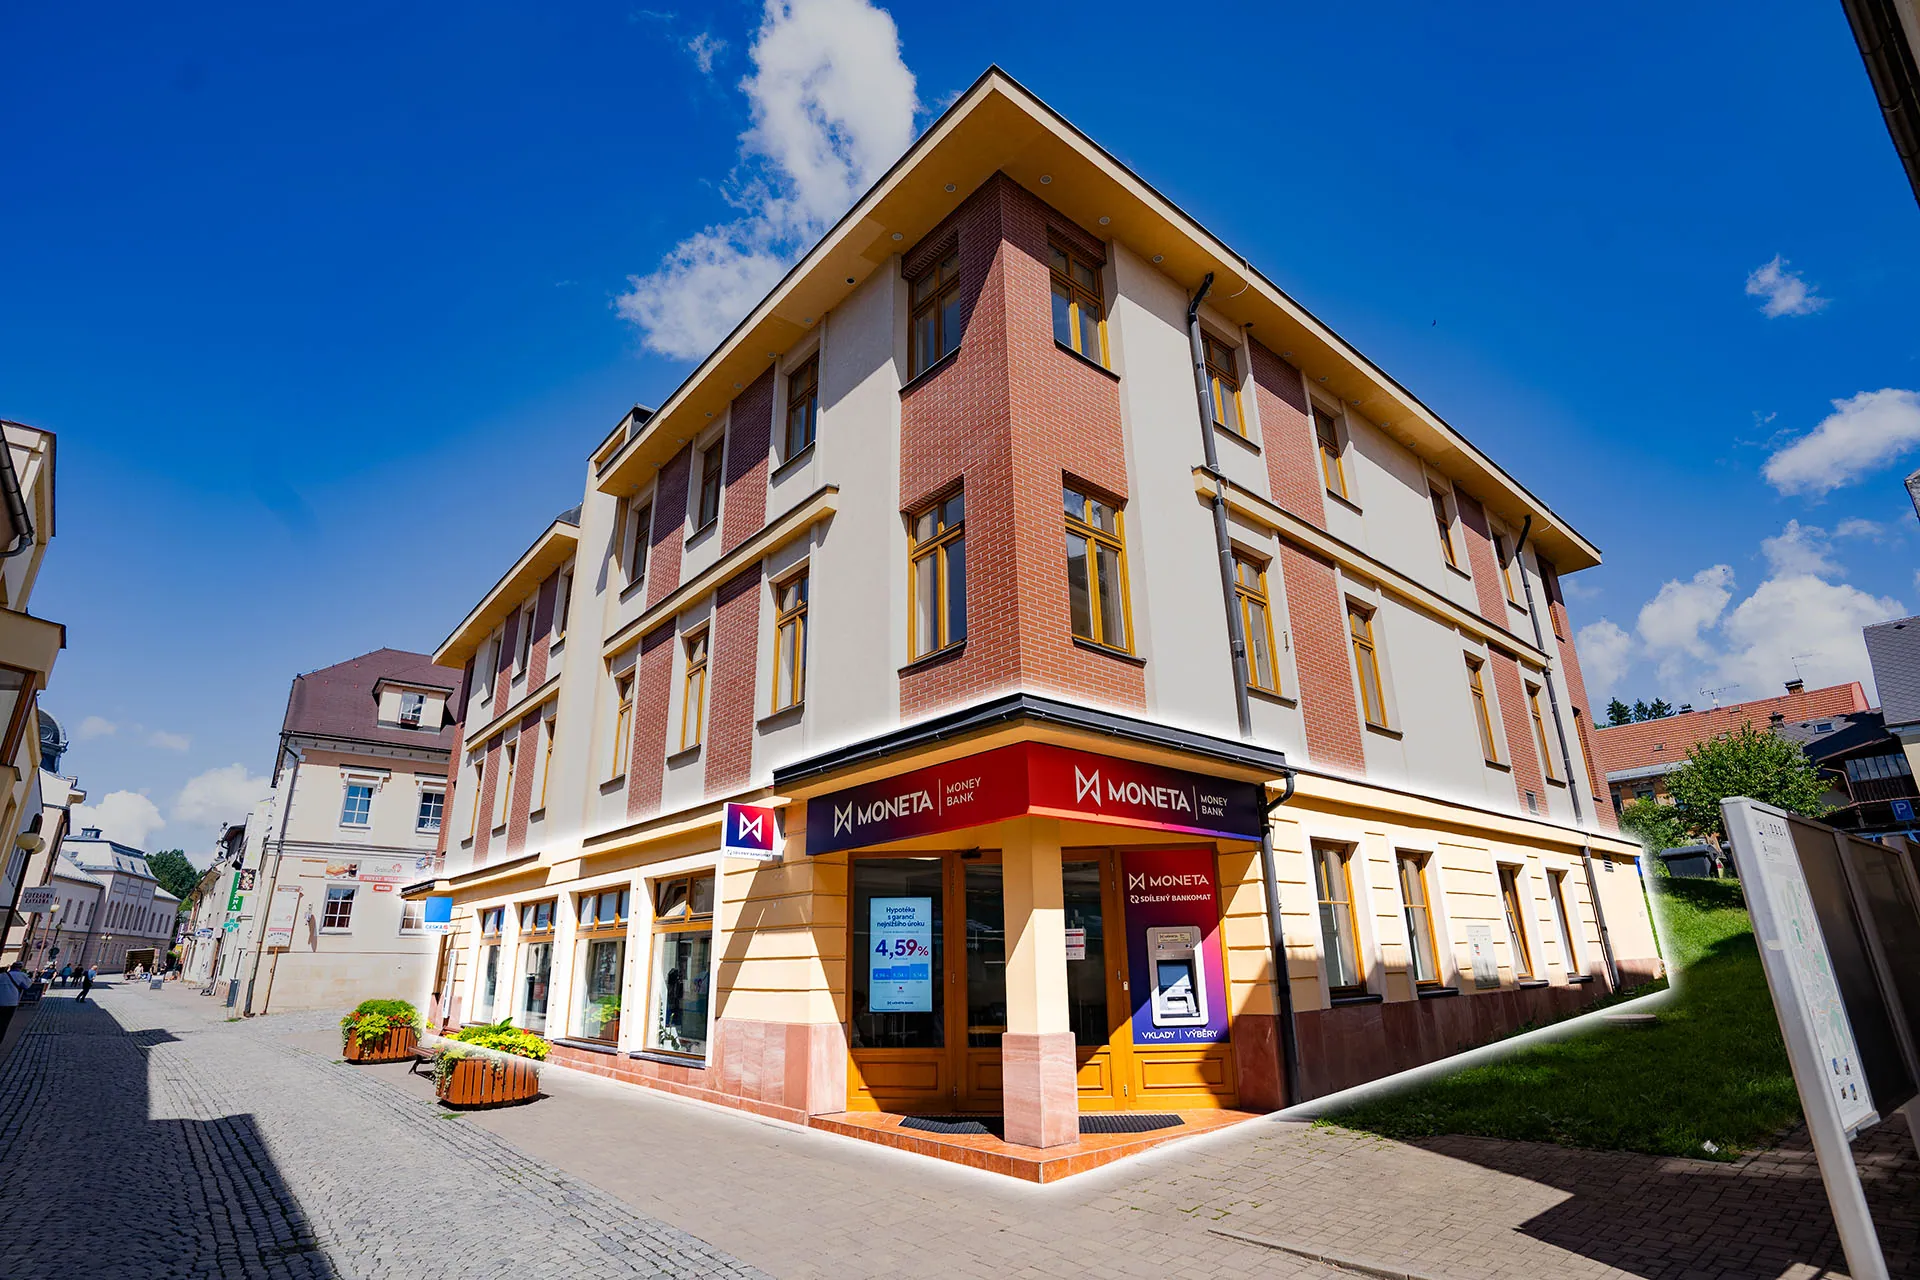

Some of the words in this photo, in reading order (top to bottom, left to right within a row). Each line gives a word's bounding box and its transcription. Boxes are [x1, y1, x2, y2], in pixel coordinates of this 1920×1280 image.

[946, 777, 981, 795] MONEY
[946, 791, 974, 807] BANK
[1107, 778, 1191, 812] MONETA
[1200, 794, 1228, 806] MONEY
[857, 790, 934, 826] MONETA
[1201, 805, 1224, 817] BANK
[1895, 802, 1907, 815] P
[1149, 874, 1209, 887] MONETA
[1140, 893, 1170, 903] SDÍLENÝ
[1171, 893, 1211, 902] BANKOMAT
[886, 906, 916, 914] Hypotéka
[891, 913, 915, 921] garancí
[877, 920, 907, 928] nejnižšího
[1142, 1030, 1176, 1039] VKLADY
[1184, 1028, 1218, 1038] VÝBĚRY
